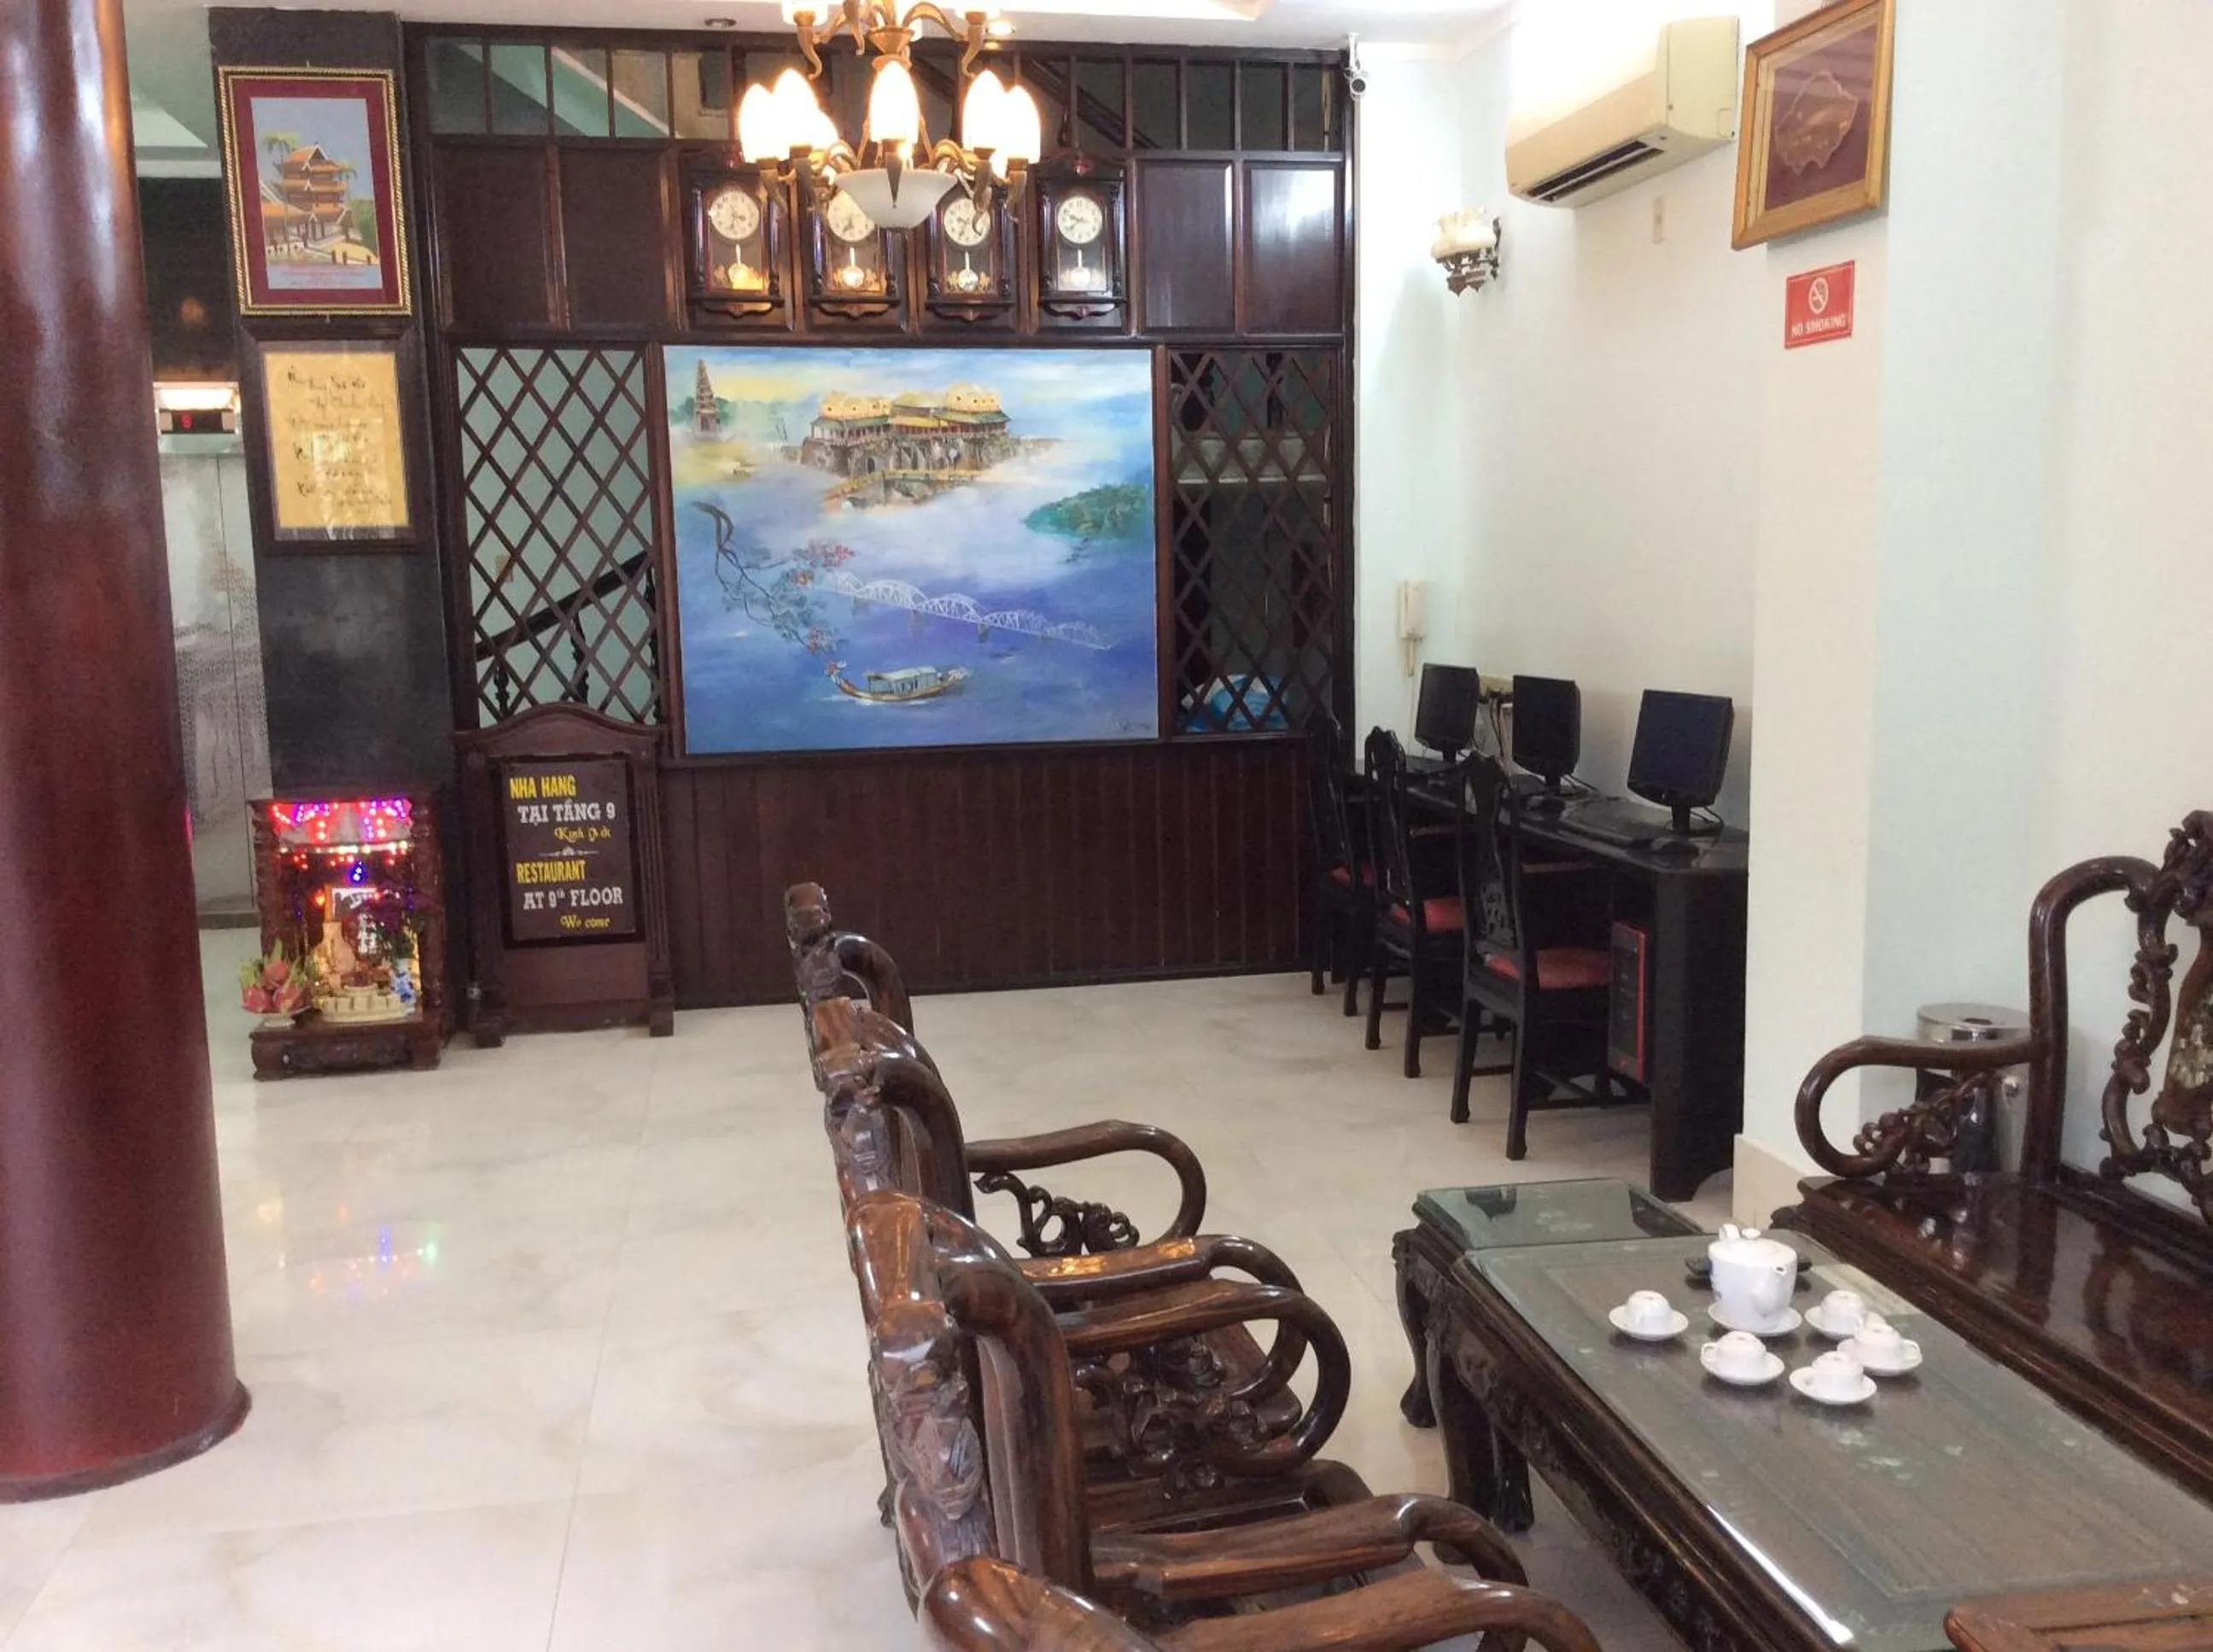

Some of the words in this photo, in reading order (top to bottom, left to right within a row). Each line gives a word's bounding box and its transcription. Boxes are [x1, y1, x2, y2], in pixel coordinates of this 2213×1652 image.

[1792, 324, 1803, 337] NO
[1806, 315, 1846, 333] SMOKING
[606, 802, 616, 820] 9
[517, 861, 587, 884] RESTAURANT
[523, 891, 545, 910] AT
[548, 888, 565, 908] 9th
[570, 887, 623, 907] FLOOR
